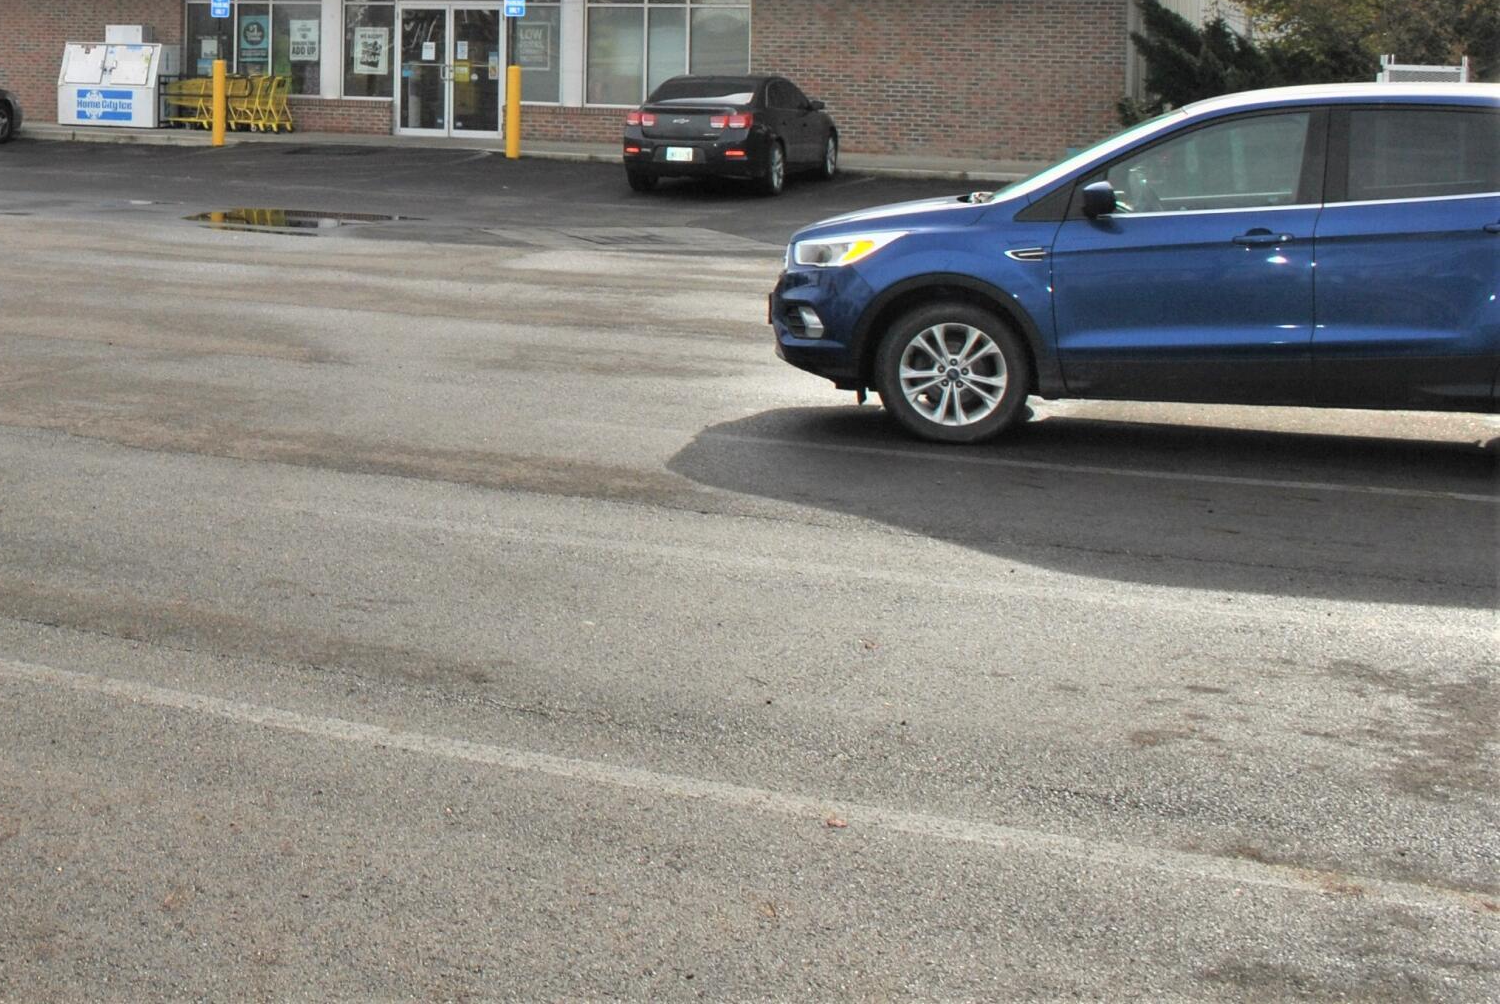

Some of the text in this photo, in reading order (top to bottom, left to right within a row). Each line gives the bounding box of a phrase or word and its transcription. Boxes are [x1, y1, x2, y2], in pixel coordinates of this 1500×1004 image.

[292, 46, 317, 55] ADD UP
[76, 99, 133, 112] Home City Ice
